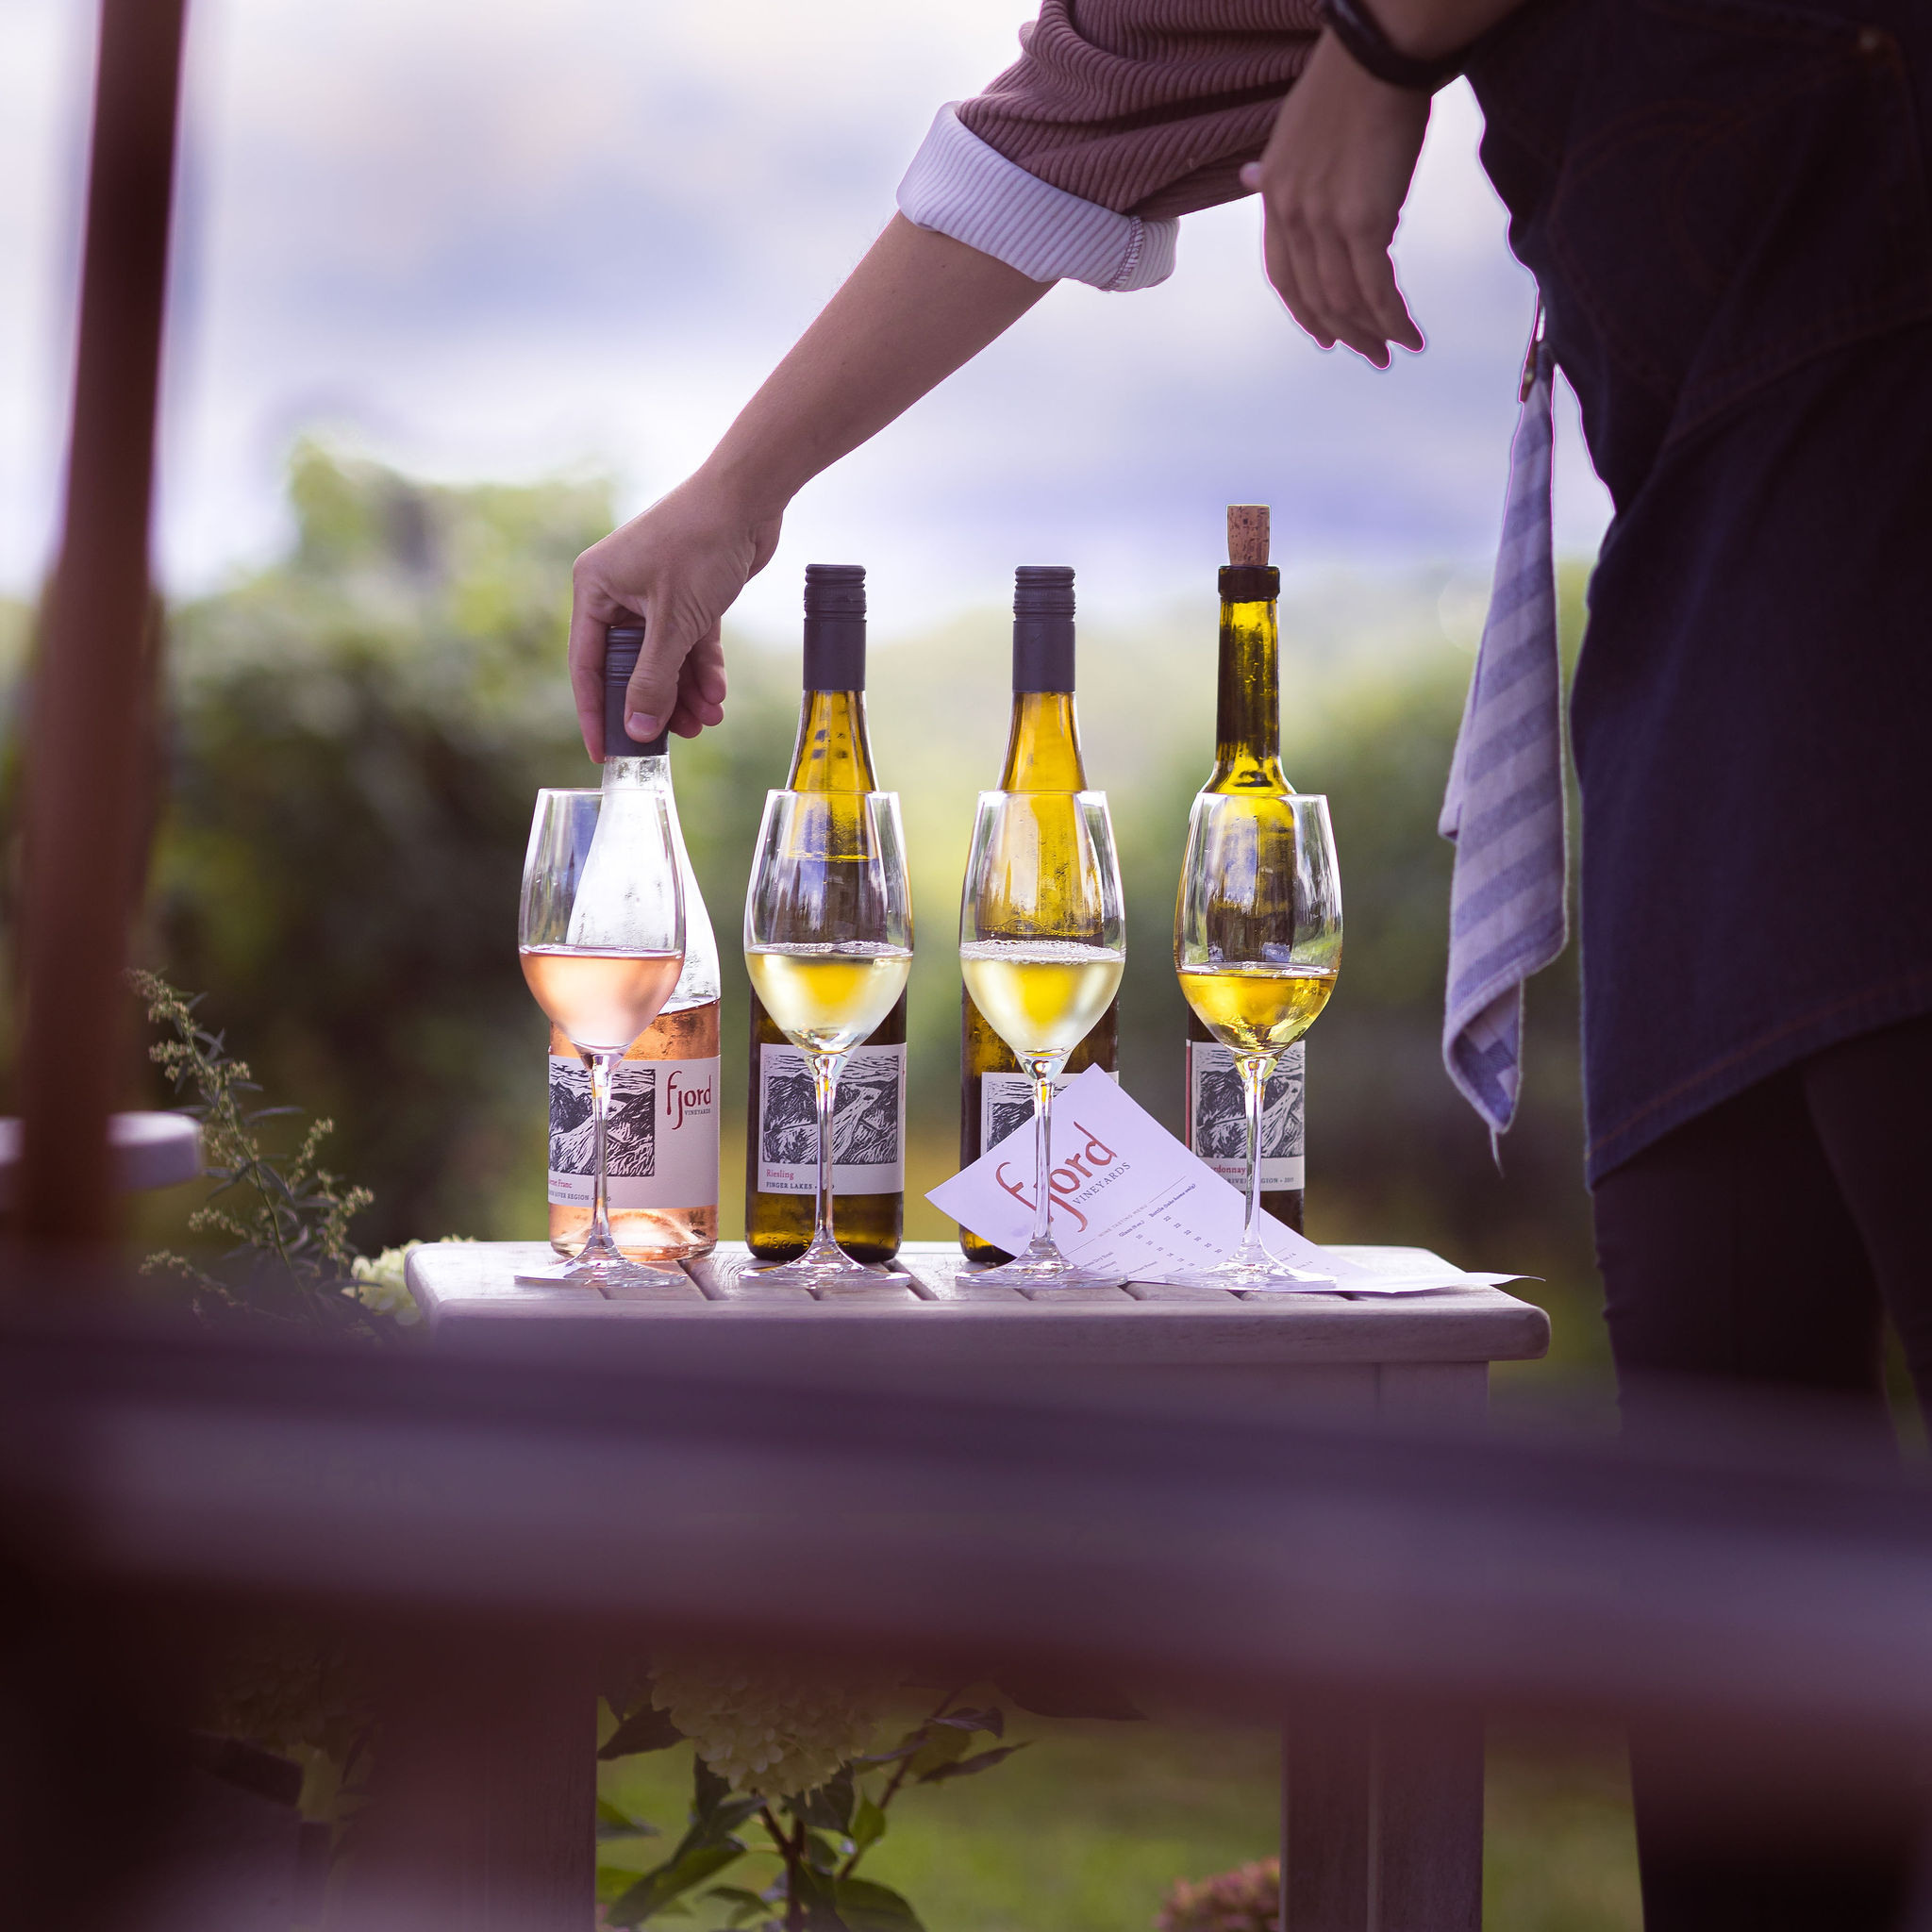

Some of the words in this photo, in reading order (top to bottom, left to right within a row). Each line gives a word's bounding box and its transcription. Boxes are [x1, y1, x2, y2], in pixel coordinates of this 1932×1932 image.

[666, 1070, 711, 1130] fjord
[684, 1108, 711, 1116] VINEYARDS
[765, 1169, 794, 1181] Riesling
[995, 1120, 1118, 1233] fjord
[1072, 1161, 1131, 1206] VINEYARDS
[1212, 1164, 1246, 1175] rdonnay
